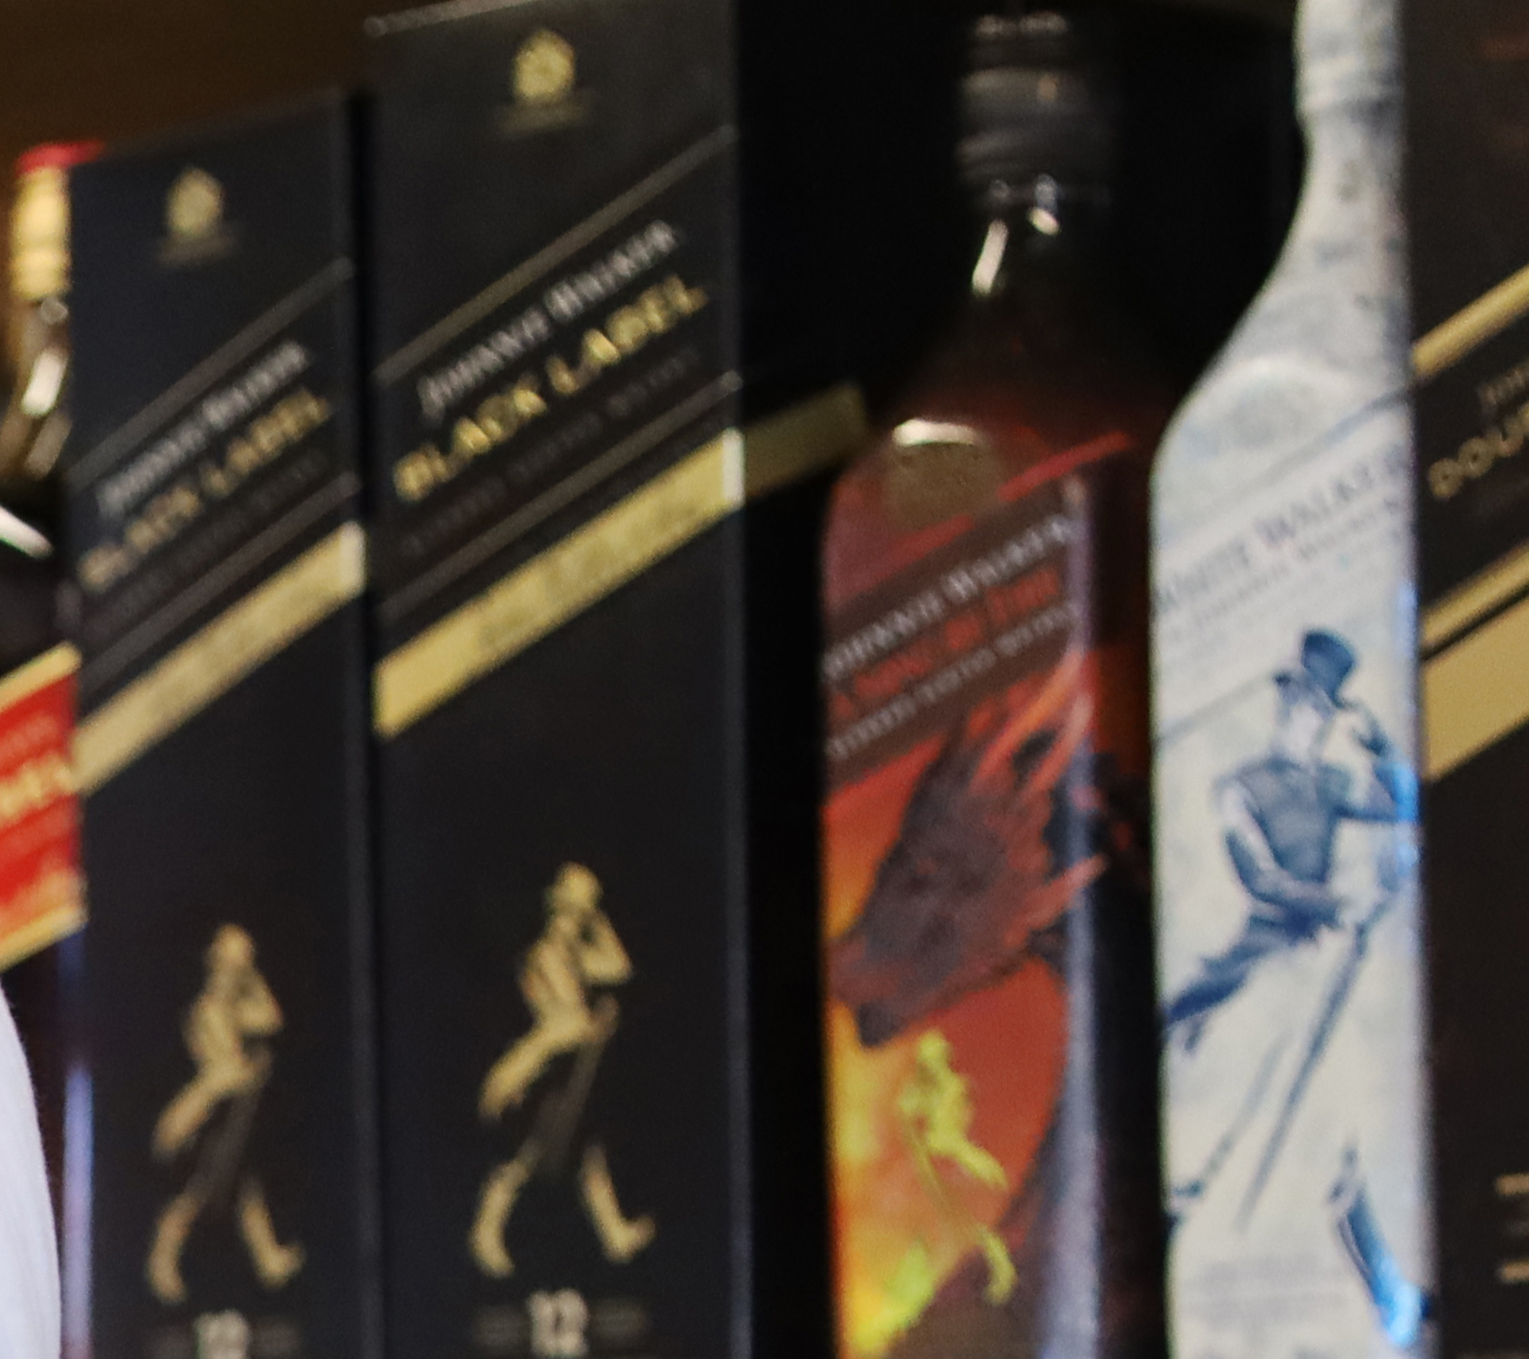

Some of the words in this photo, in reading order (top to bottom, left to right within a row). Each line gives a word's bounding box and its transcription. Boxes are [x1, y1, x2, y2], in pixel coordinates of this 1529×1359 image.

[197, 387, 333, 500] LABEL
[392, 370, 548, 506] BLACK
[546, 274, 710, 398] LABEL
